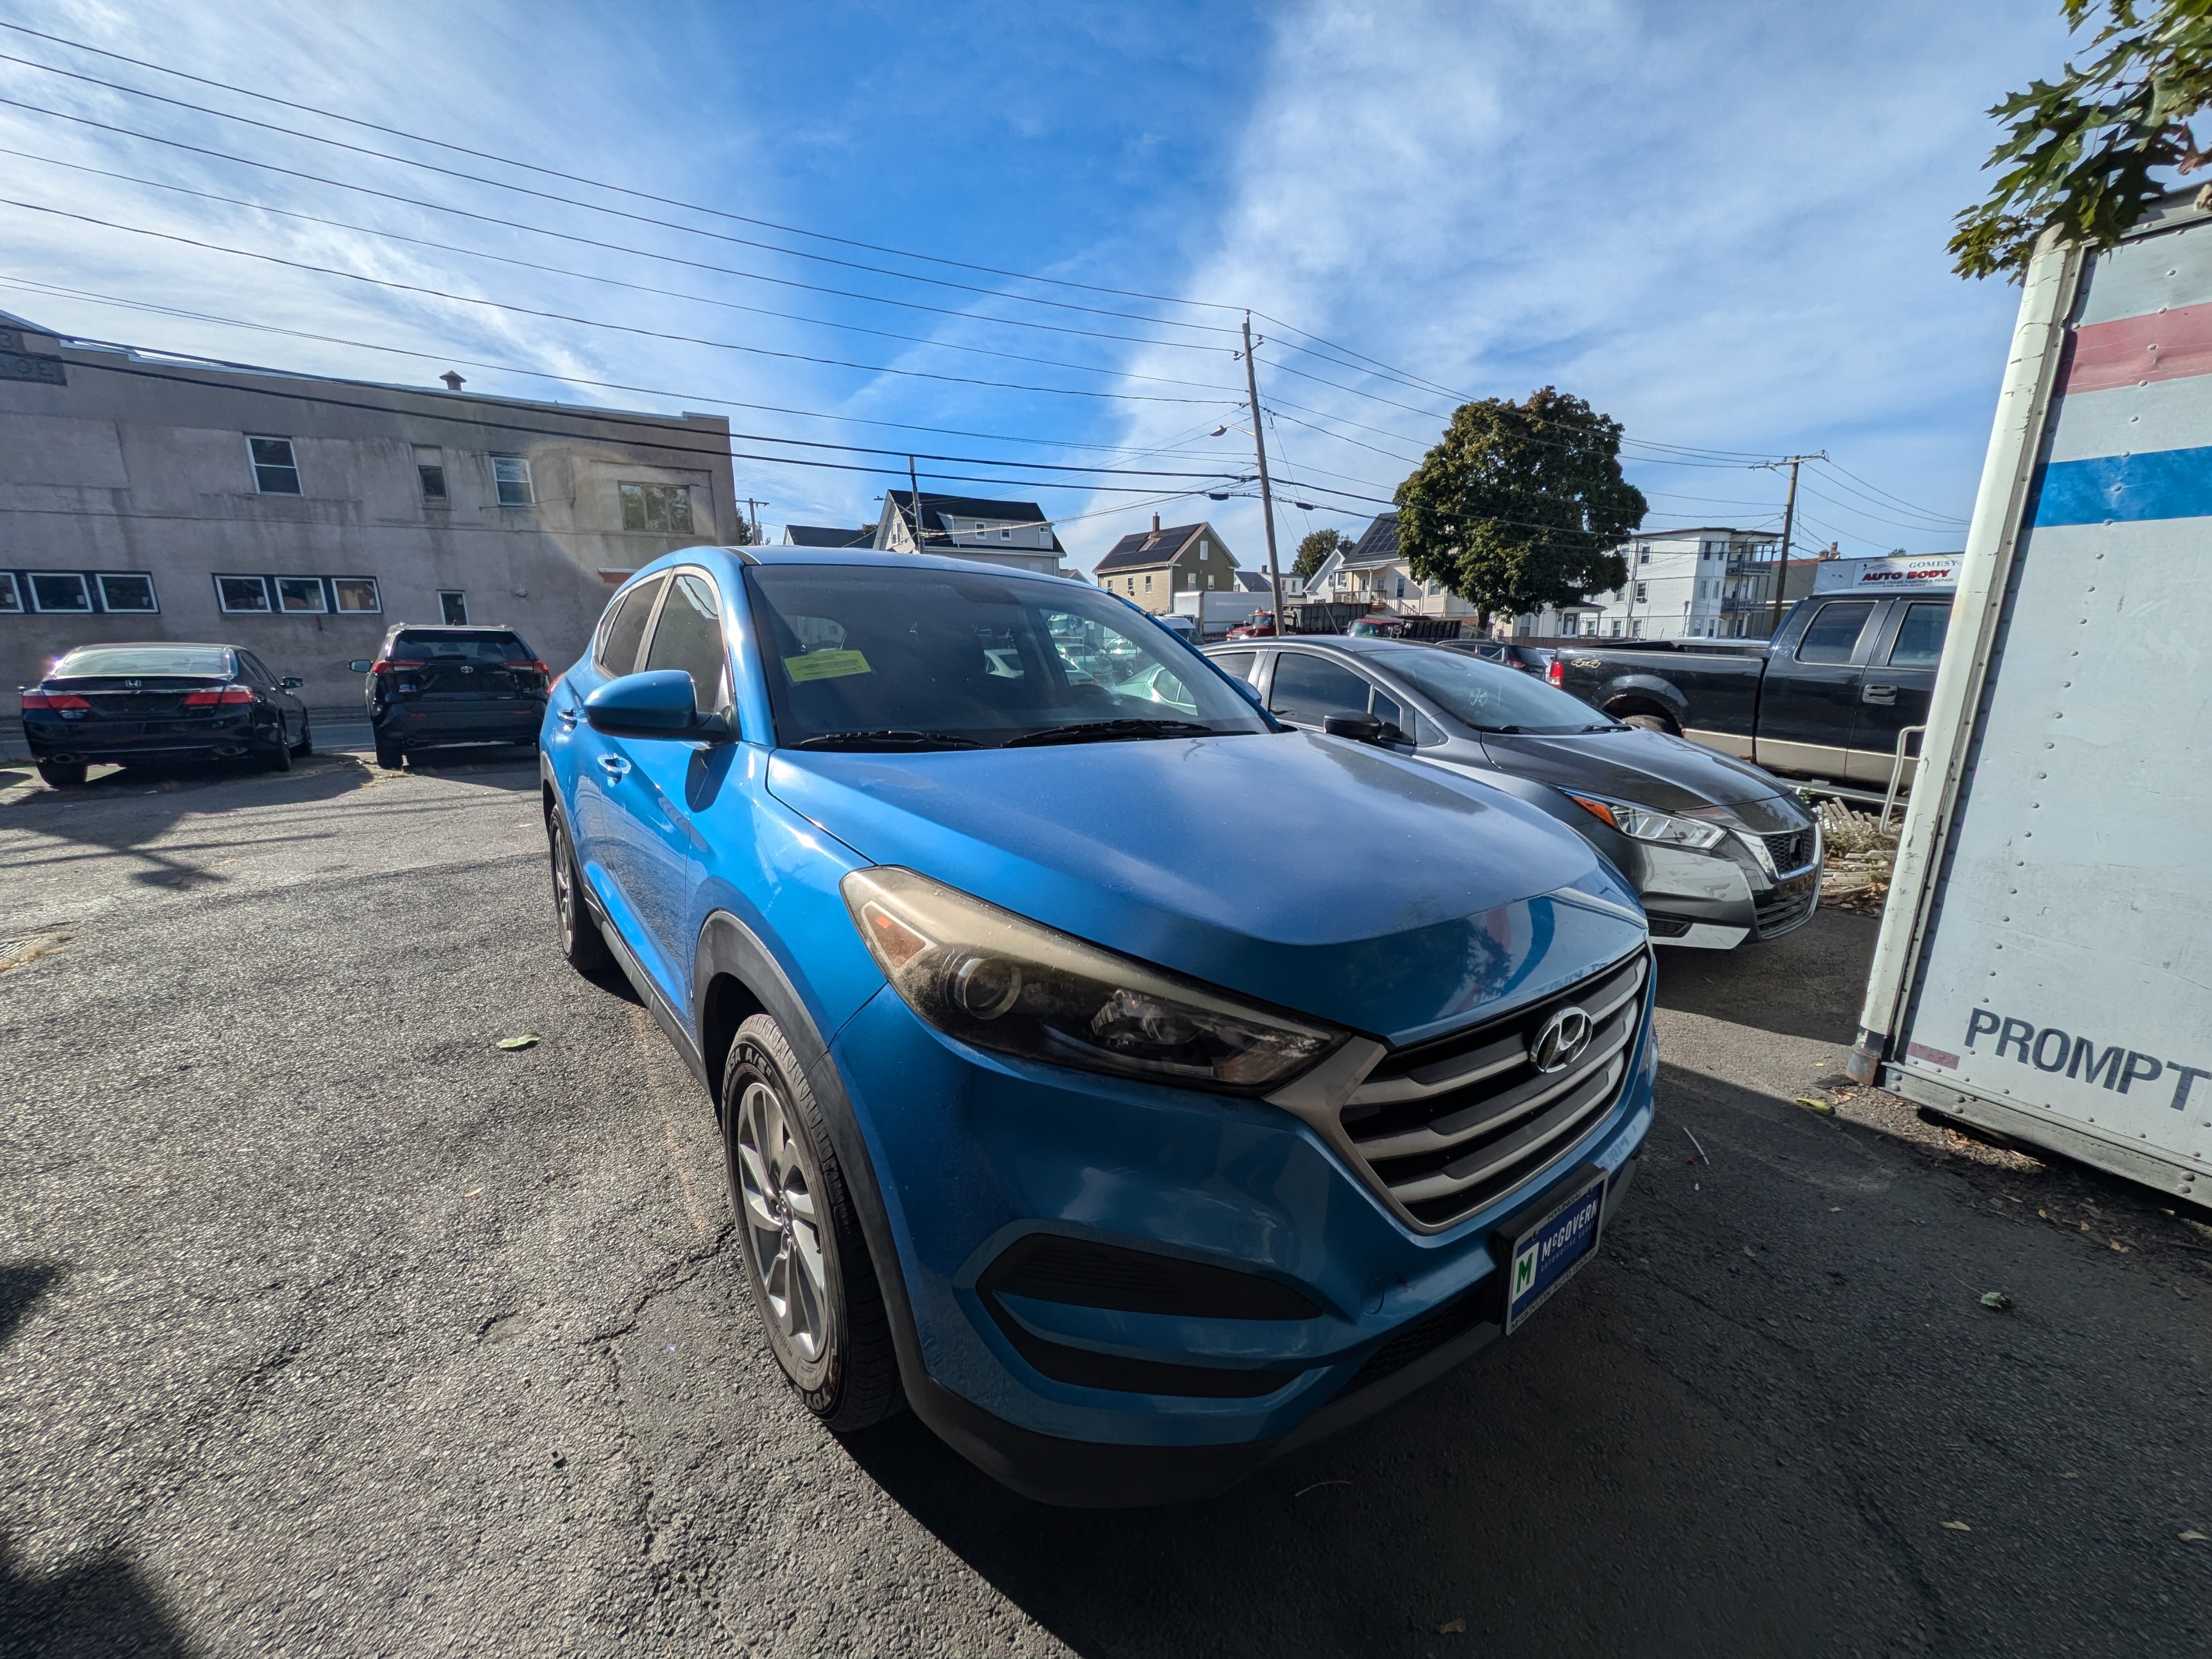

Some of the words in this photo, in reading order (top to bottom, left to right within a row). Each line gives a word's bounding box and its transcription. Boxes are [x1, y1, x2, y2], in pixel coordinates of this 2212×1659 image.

[1861, 571, 1903, 581] AUTO
[1906, 569, 1952, 580] BODY
[1964, 1007, 2211, 1112] PROMPT
[1547, 1191, 1581, 1222] HYUNDAI
[1540, 1238, 1577, 1274] AUTOMOTIVE
[1516, 1251, 1533, 1295] M
[1553, 1271, 1572, 1292] AUTO
